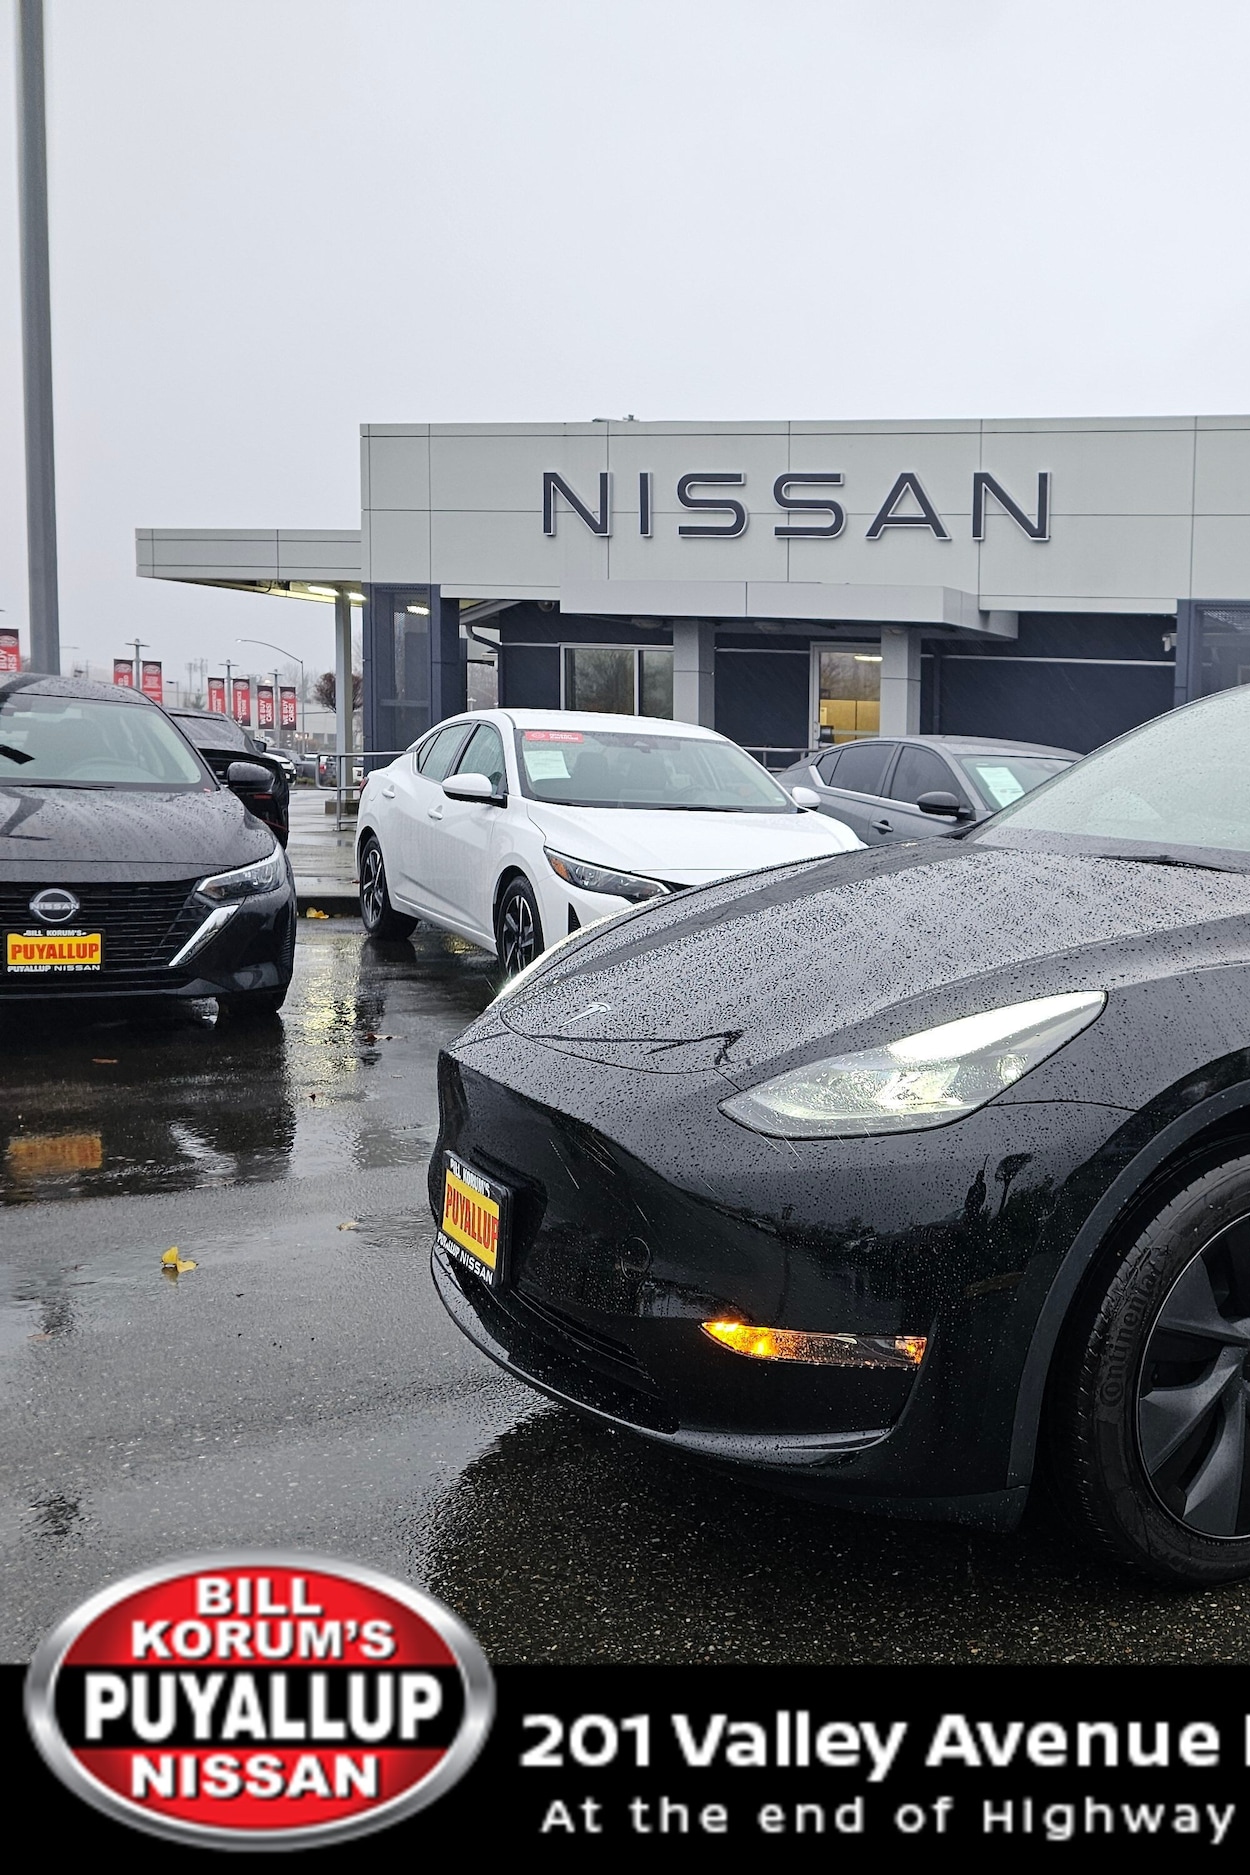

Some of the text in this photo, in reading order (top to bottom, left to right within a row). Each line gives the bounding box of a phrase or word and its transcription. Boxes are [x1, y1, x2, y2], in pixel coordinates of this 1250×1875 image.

[542, 471, 1052, 542] NISSAN
[260, 714, 266, 725] WE
[282, 714, 289, 726] WE
[29, 902, 80, 910] NISSAN
[11, 943, 99, 960] PUYALLUP
[7, 965, 51, 973] PUYALLUP
[463, 1167, 491, 1198] KORUM'S
[445, 1183, 499, 1253] PUYALLUP
[459, 1250, 494, 1286] NISSAN
